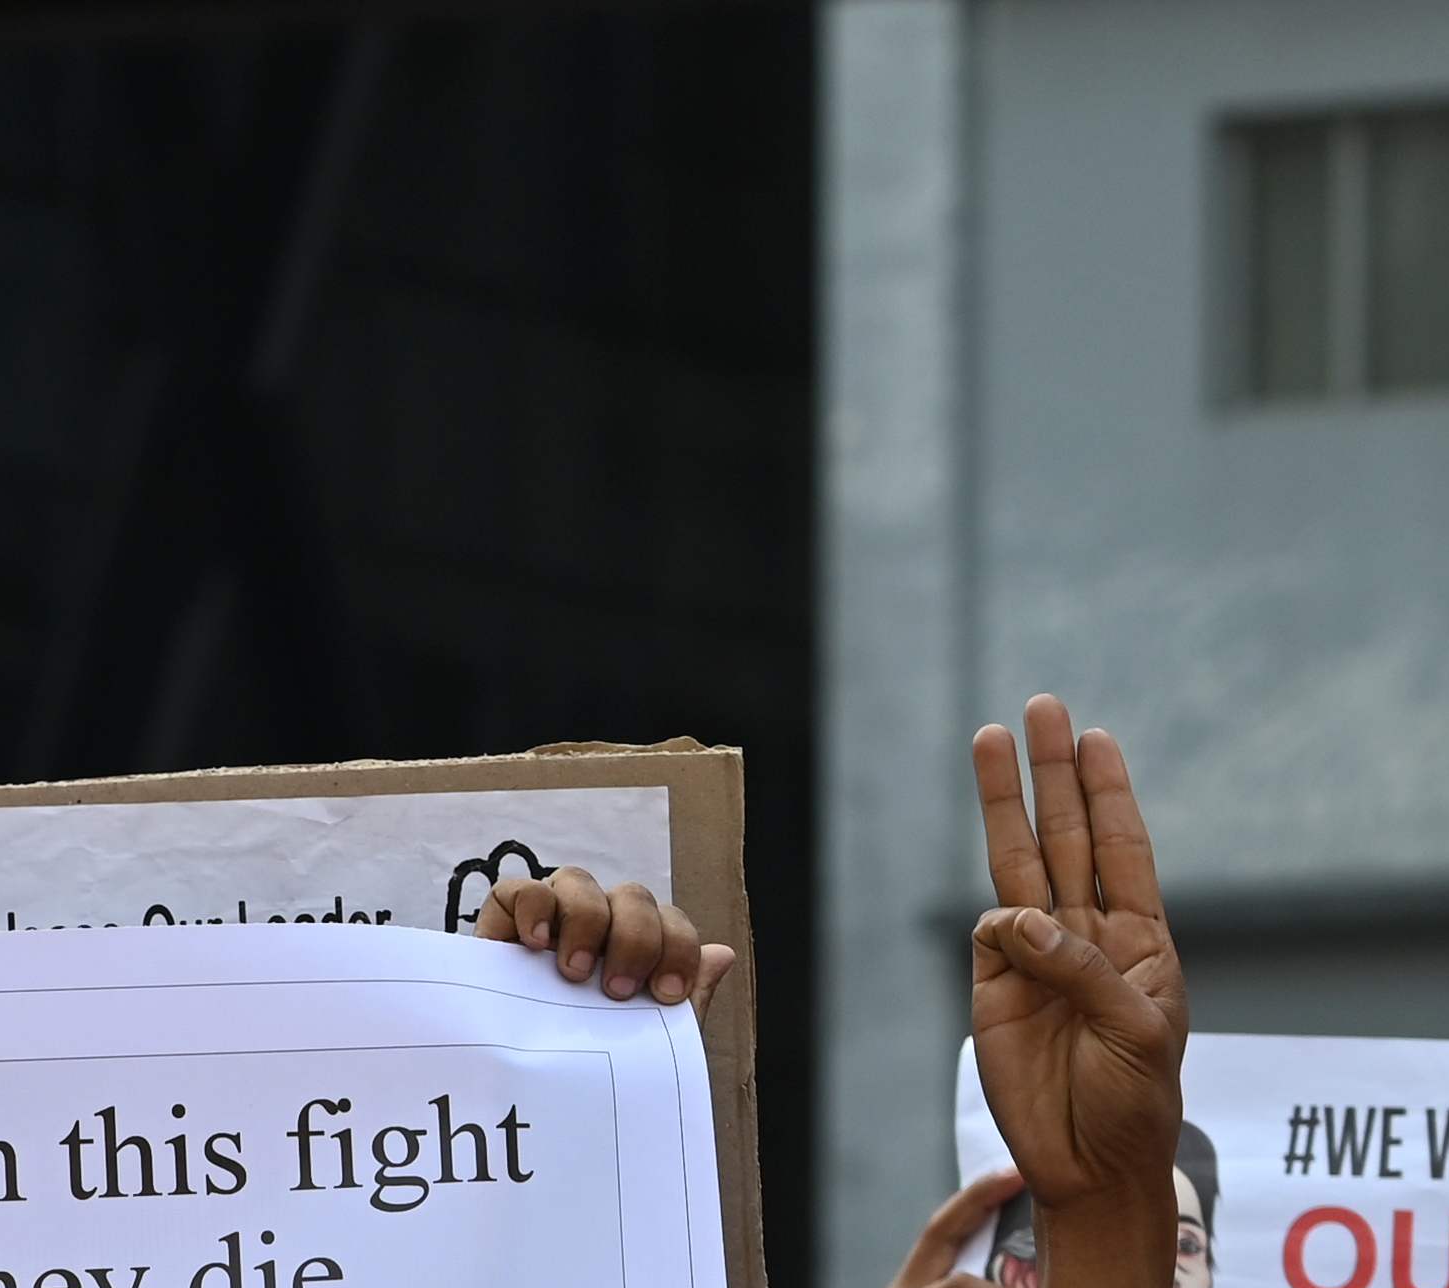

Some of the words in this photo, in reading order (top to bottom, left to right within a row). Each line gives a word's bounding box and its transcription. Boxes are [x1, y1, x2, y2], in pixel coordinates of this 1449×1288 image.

[59, 1104, 246, 1200] this
[287, 1094, 533, 1212] fight
[1284, 1105, 1407, 1178] #WE
